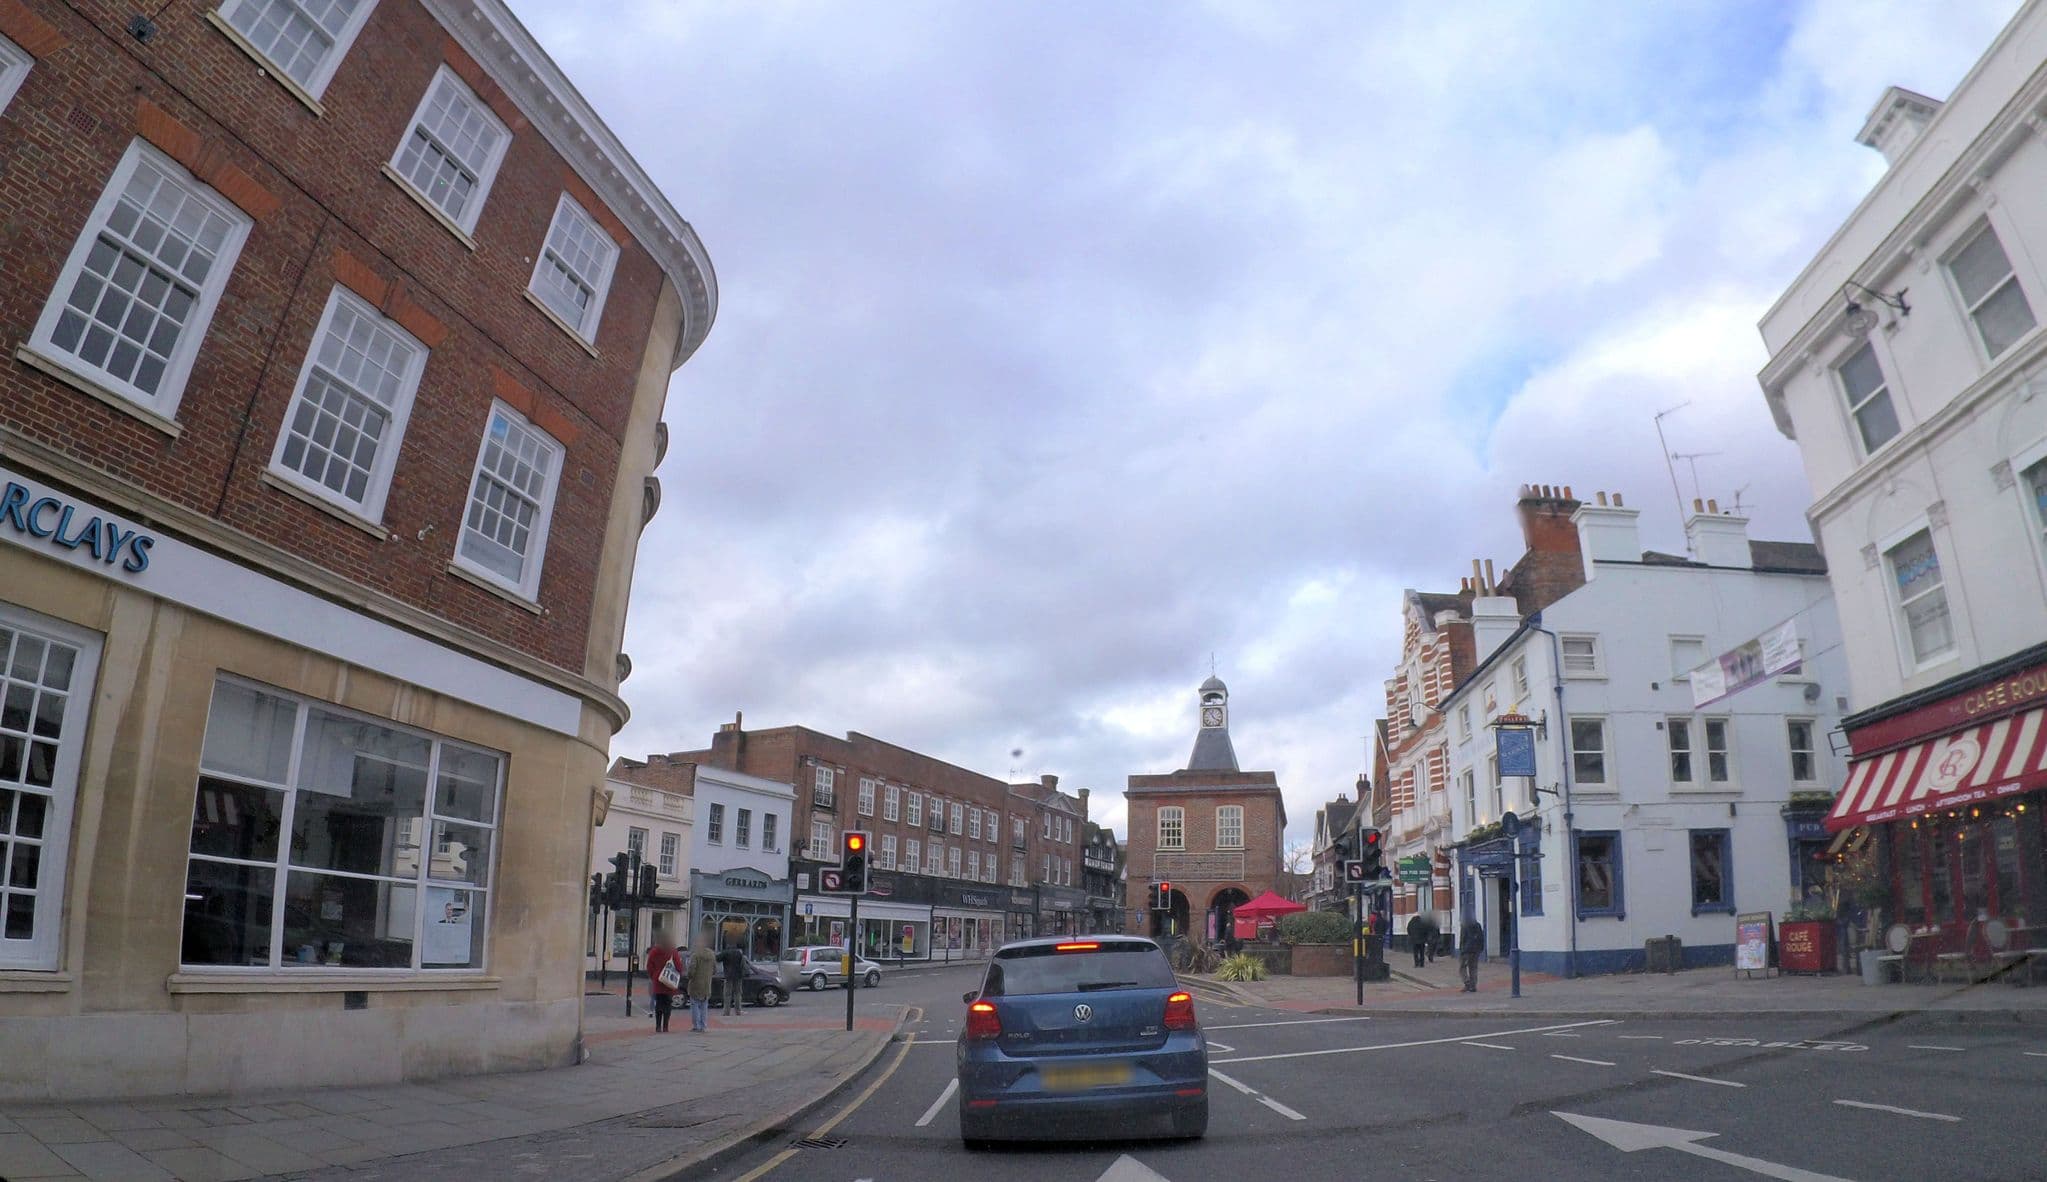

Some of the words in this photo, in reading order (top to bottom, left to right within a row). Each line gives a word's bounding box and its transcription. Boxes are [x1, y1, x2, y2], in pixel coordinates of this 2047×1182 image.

[0, 481, 155, 572] RCLAYS
[1965, 682, 2007, 715] CAFÉ
[1906, 804, 1925, 814] LUNCH
[1936, 793, 1972, 808] AFTERNOON
[1974, 790, 1986, 799] TEA
[1997, 782, 2021, 795] DINNER
[1785, 942, 1814, 953] ROUGE
